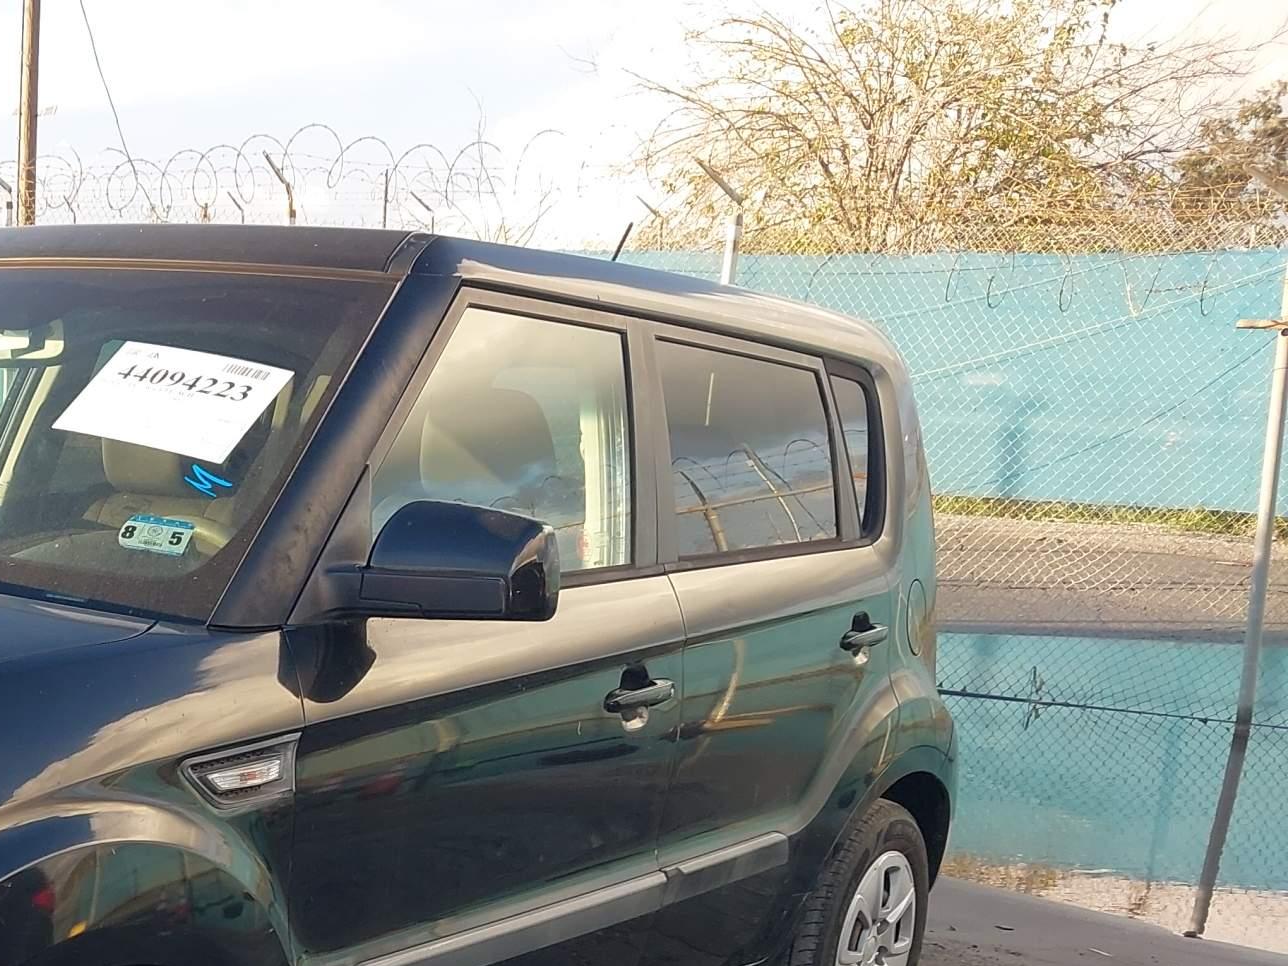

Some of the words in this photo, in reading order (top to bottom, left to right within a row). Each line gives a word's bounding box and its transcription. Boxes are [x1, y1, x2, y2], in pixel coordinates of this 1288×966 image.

[117, 364, 253, 401] 44094223
[121, 525, 137, 539] 8
[168, 531, 185, 546] 5
